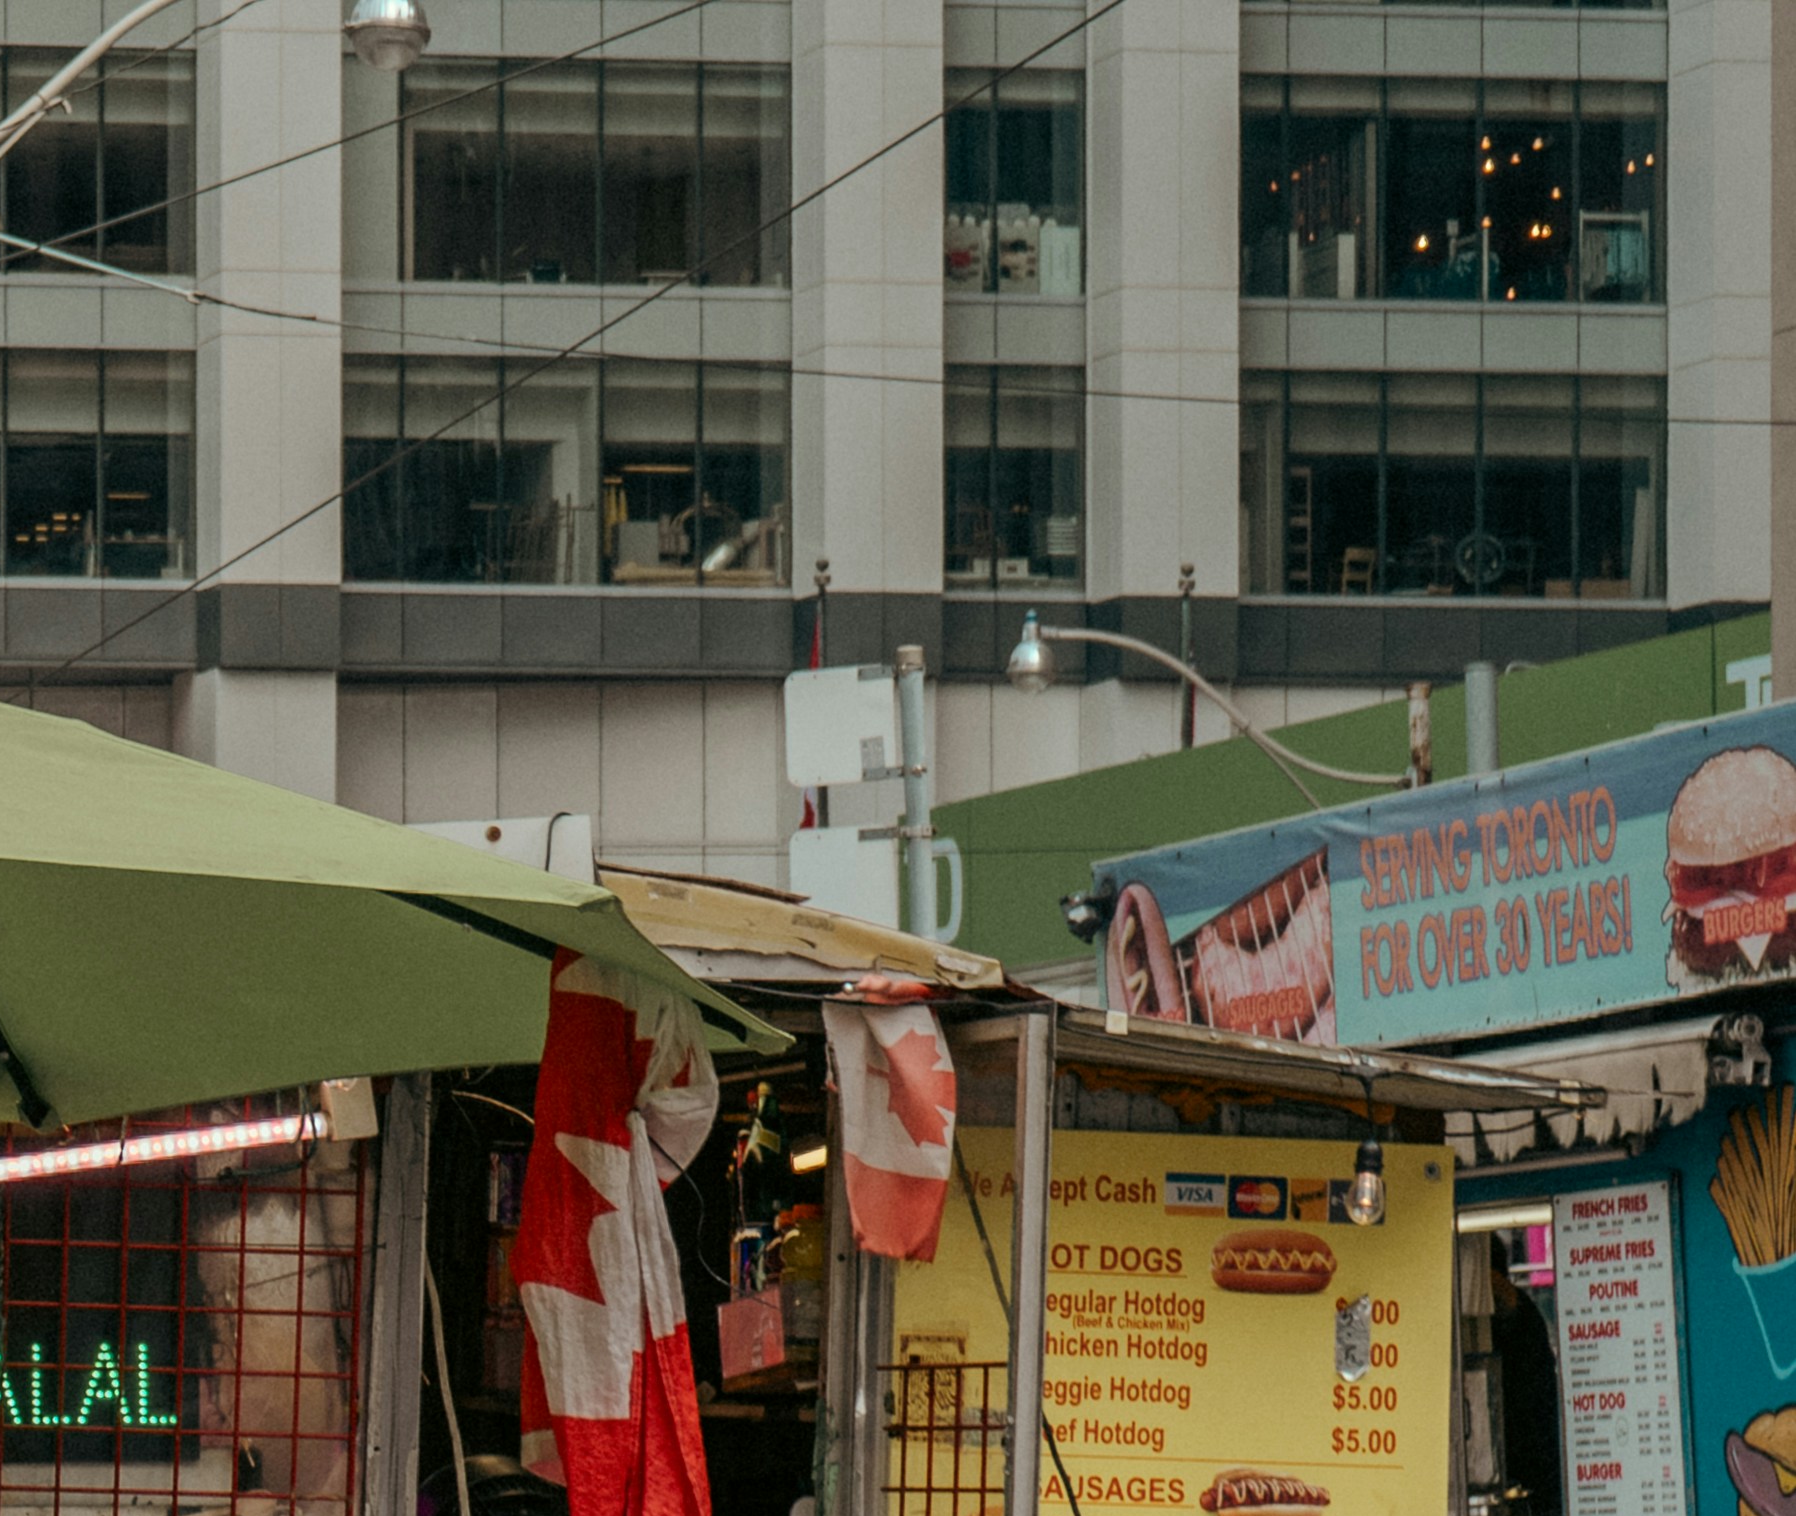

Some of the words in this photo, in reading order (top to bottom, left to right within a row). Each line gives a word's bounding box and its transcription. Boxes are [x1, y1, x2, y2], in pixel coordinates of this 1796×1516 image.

[1359, 818, 1473, 912] SERVING
[1476, 787, 1617, 889] TORONTO
[1703, 898, 1788, 944] BURGERS
[1359, 919, 1414, 1000] FOR
[1417, 901, 1490, 989] OVER
[1494, 898, 1531, 978] 30
[1533, 876, 1633, 971] YEARS!
[1094, 1176, 1156, 1203] Cash
[1177, 1188, 1214, 1202] VISA
[1572, 1198, 1615, 1221] FRENCH
[1617, 1194, 1648, 1214] FRIES
[1099, 1245, 1183, 1273] DOGS
[1570, 1243, 1622, 1266] SUPREME
[1625, 1240, 1655, 1261] FRIES
[1589, 1280, 1639, 1300] POUTINE
[1124, 1291, 1205, 1323] Hotdog
[1072, 1315, 1105, 1331] (Beef
[1117, 1318, 1163, 1330] Chicken
[1165, 1318, 1190, 1332] Mix)
[1568, 1320, 1621, 1342] SAUSAGE
[1126, 1334, 1208, 1367] Hotdog
[1110, 1377, 1191, 1410] Hotdog
[1333, 1384, 1398, 1412] $5.00
[1573, 1393, 1595, 1413] HOT
[1599, 1392, 1626, 1410] DOG
[1083, 1420, 1165, 1452] Hotdog
[1331, 1427, 1397, 1455] $5.00
[1576, 1462, 1623, 1481] BURGER
